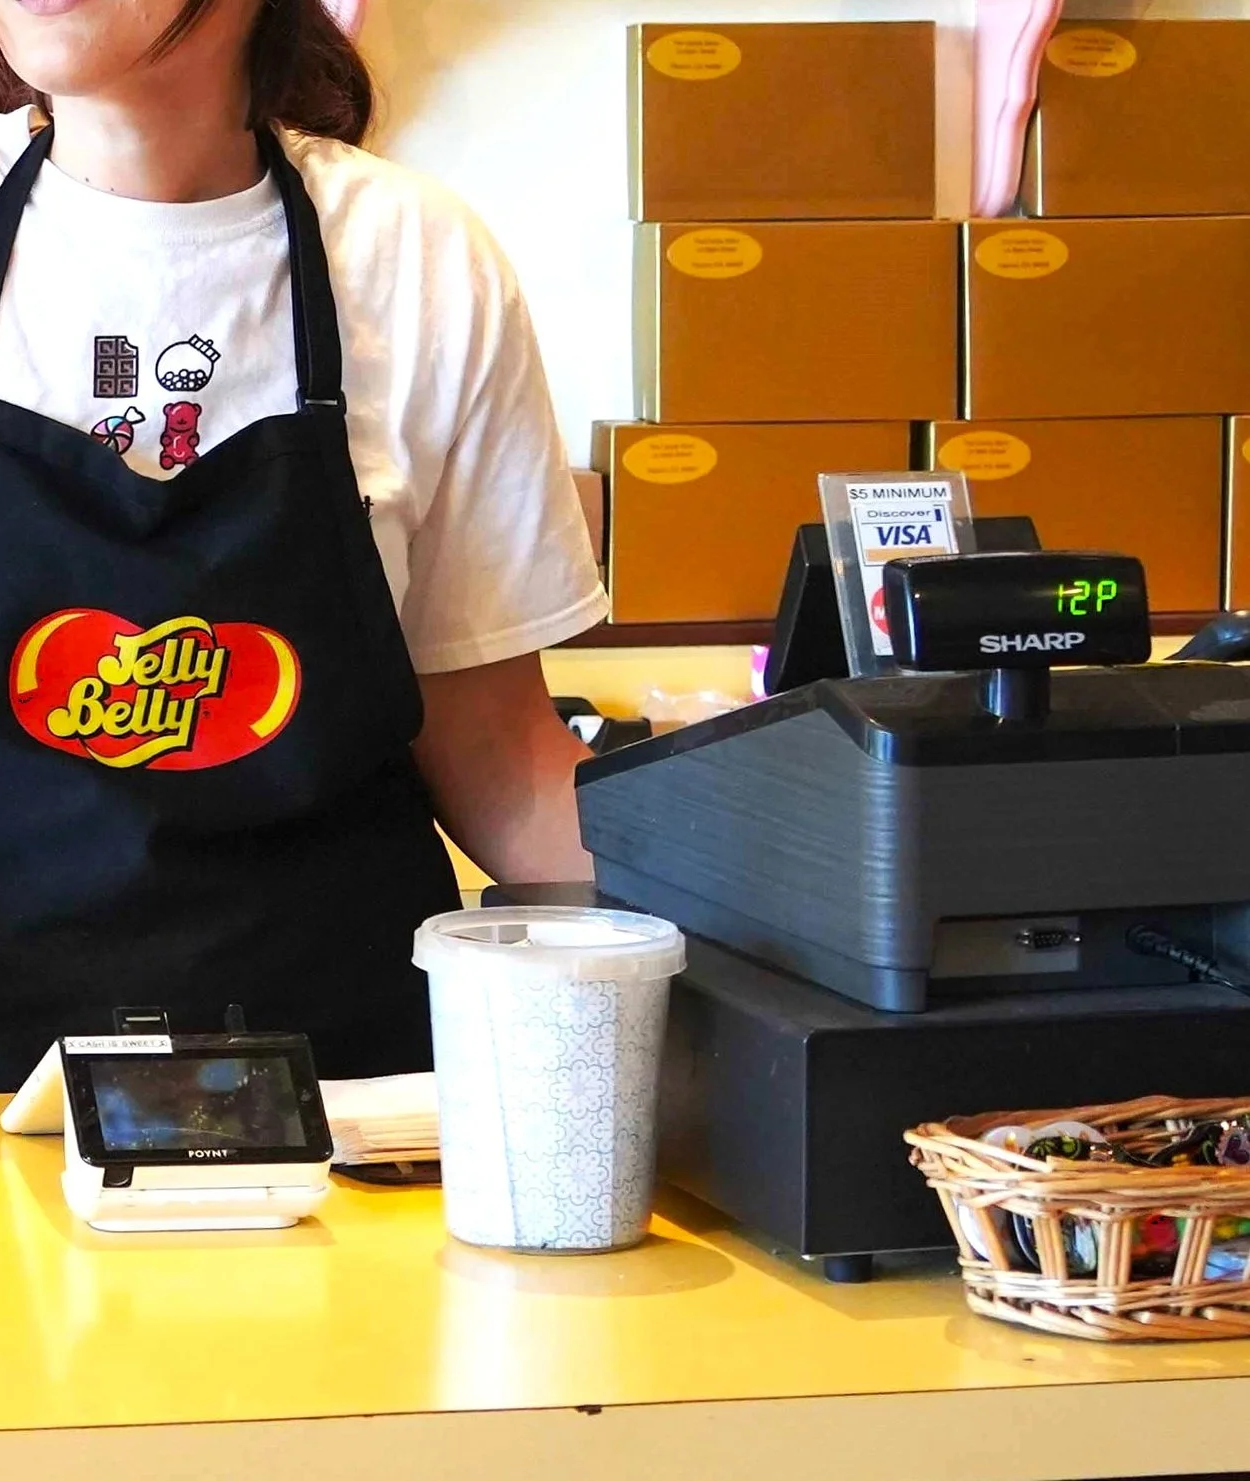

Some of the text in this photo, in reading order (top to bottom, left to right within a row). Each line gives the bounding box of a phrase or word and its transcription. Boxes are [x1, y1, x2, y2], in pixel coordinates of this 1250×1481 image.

[849, 487, 947, 500] $5 MINIMUM
[867, 509, 932, 519] Discover
[876, 525, 932, 546] VISA
[979, 632, 1085, 653] SHARP
[98, 616, 225, 698] Jelly
[47, 677, 197, 768] Belly
[188, 1149, 228, 1159] POYNT
